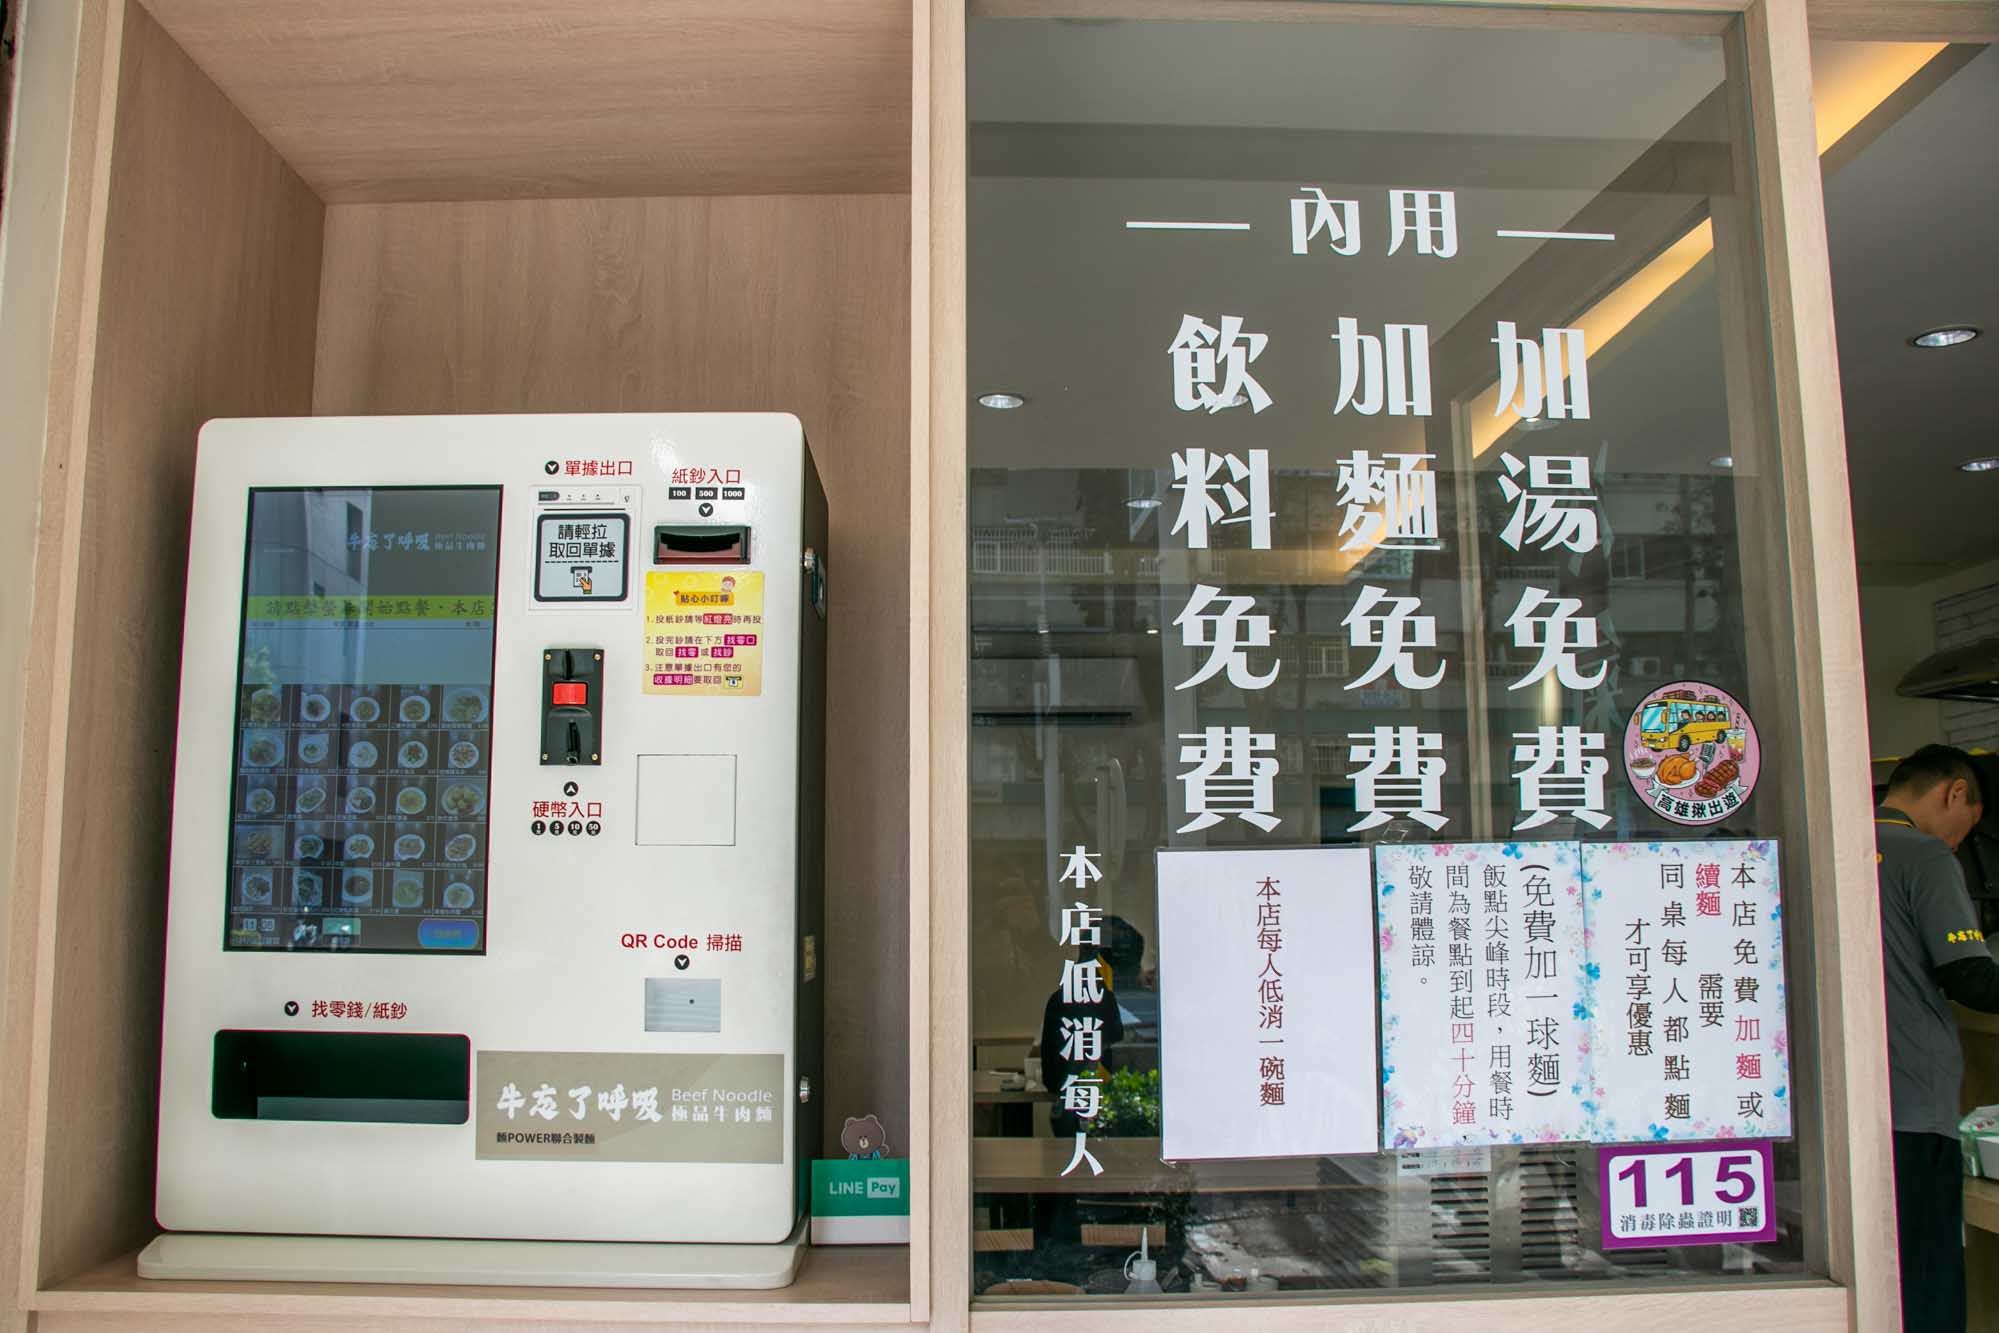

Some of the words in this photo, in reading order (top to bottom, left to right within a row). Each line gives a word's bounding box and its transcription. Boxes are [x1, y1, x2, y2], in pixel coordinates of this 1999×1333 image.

[1290, 187, 1458, 258] 內用
[564, 460, 633, 477] 單據出口
[671, 468, 741, 485] 紙鈔入口
[671, 489, 687, 498] 100
[698, 489, 714, 498] 500
[723, 489, 743, 498] 1000
[557, 524, 608, 541] 請輕拉
[549, 542, 616, 559] 取回單據
[1167, 313, 1282, 834] 飲料免費
[1330, 316, 1451, 834] 加麵免費
[1490, 320, 1613, 834] 加湯免費
[532, 800, 603, 818] 硬幣入口
[1657, 791, 1741, 818] 高雄揪出遊
[621, 933, 648, 949] QR
[653, 934, 699, 949] Code
[706, 933, 743, 952] 掃描
[1255, 876, 1286, 1107] 本店每人低消一碗麵
[1625, 918, 1653, 1057] 才可享優惠
[1660, 863, 1692, 1120] 同桌每人都點麵
[1698, 973, 1726, 1028] 需要
[311, 1000, 408, 1020] 找零錢/紙鈔
[1058, 845, 1105, 1178] 本店低消每人
[496, 1082, 664, 1123] 牛忘了呼吸
[671, 1088, 708, 1102] Beef
[713, 1089, 773, 1103] Noodle
[829, 1181, 864, 1195] LINE
[870, 1182, 897, 1196] Pay
[1618, 1155, 1756, 1208] 115
[1620, 1209, 1733, 1233] 消毒除蟲證明
